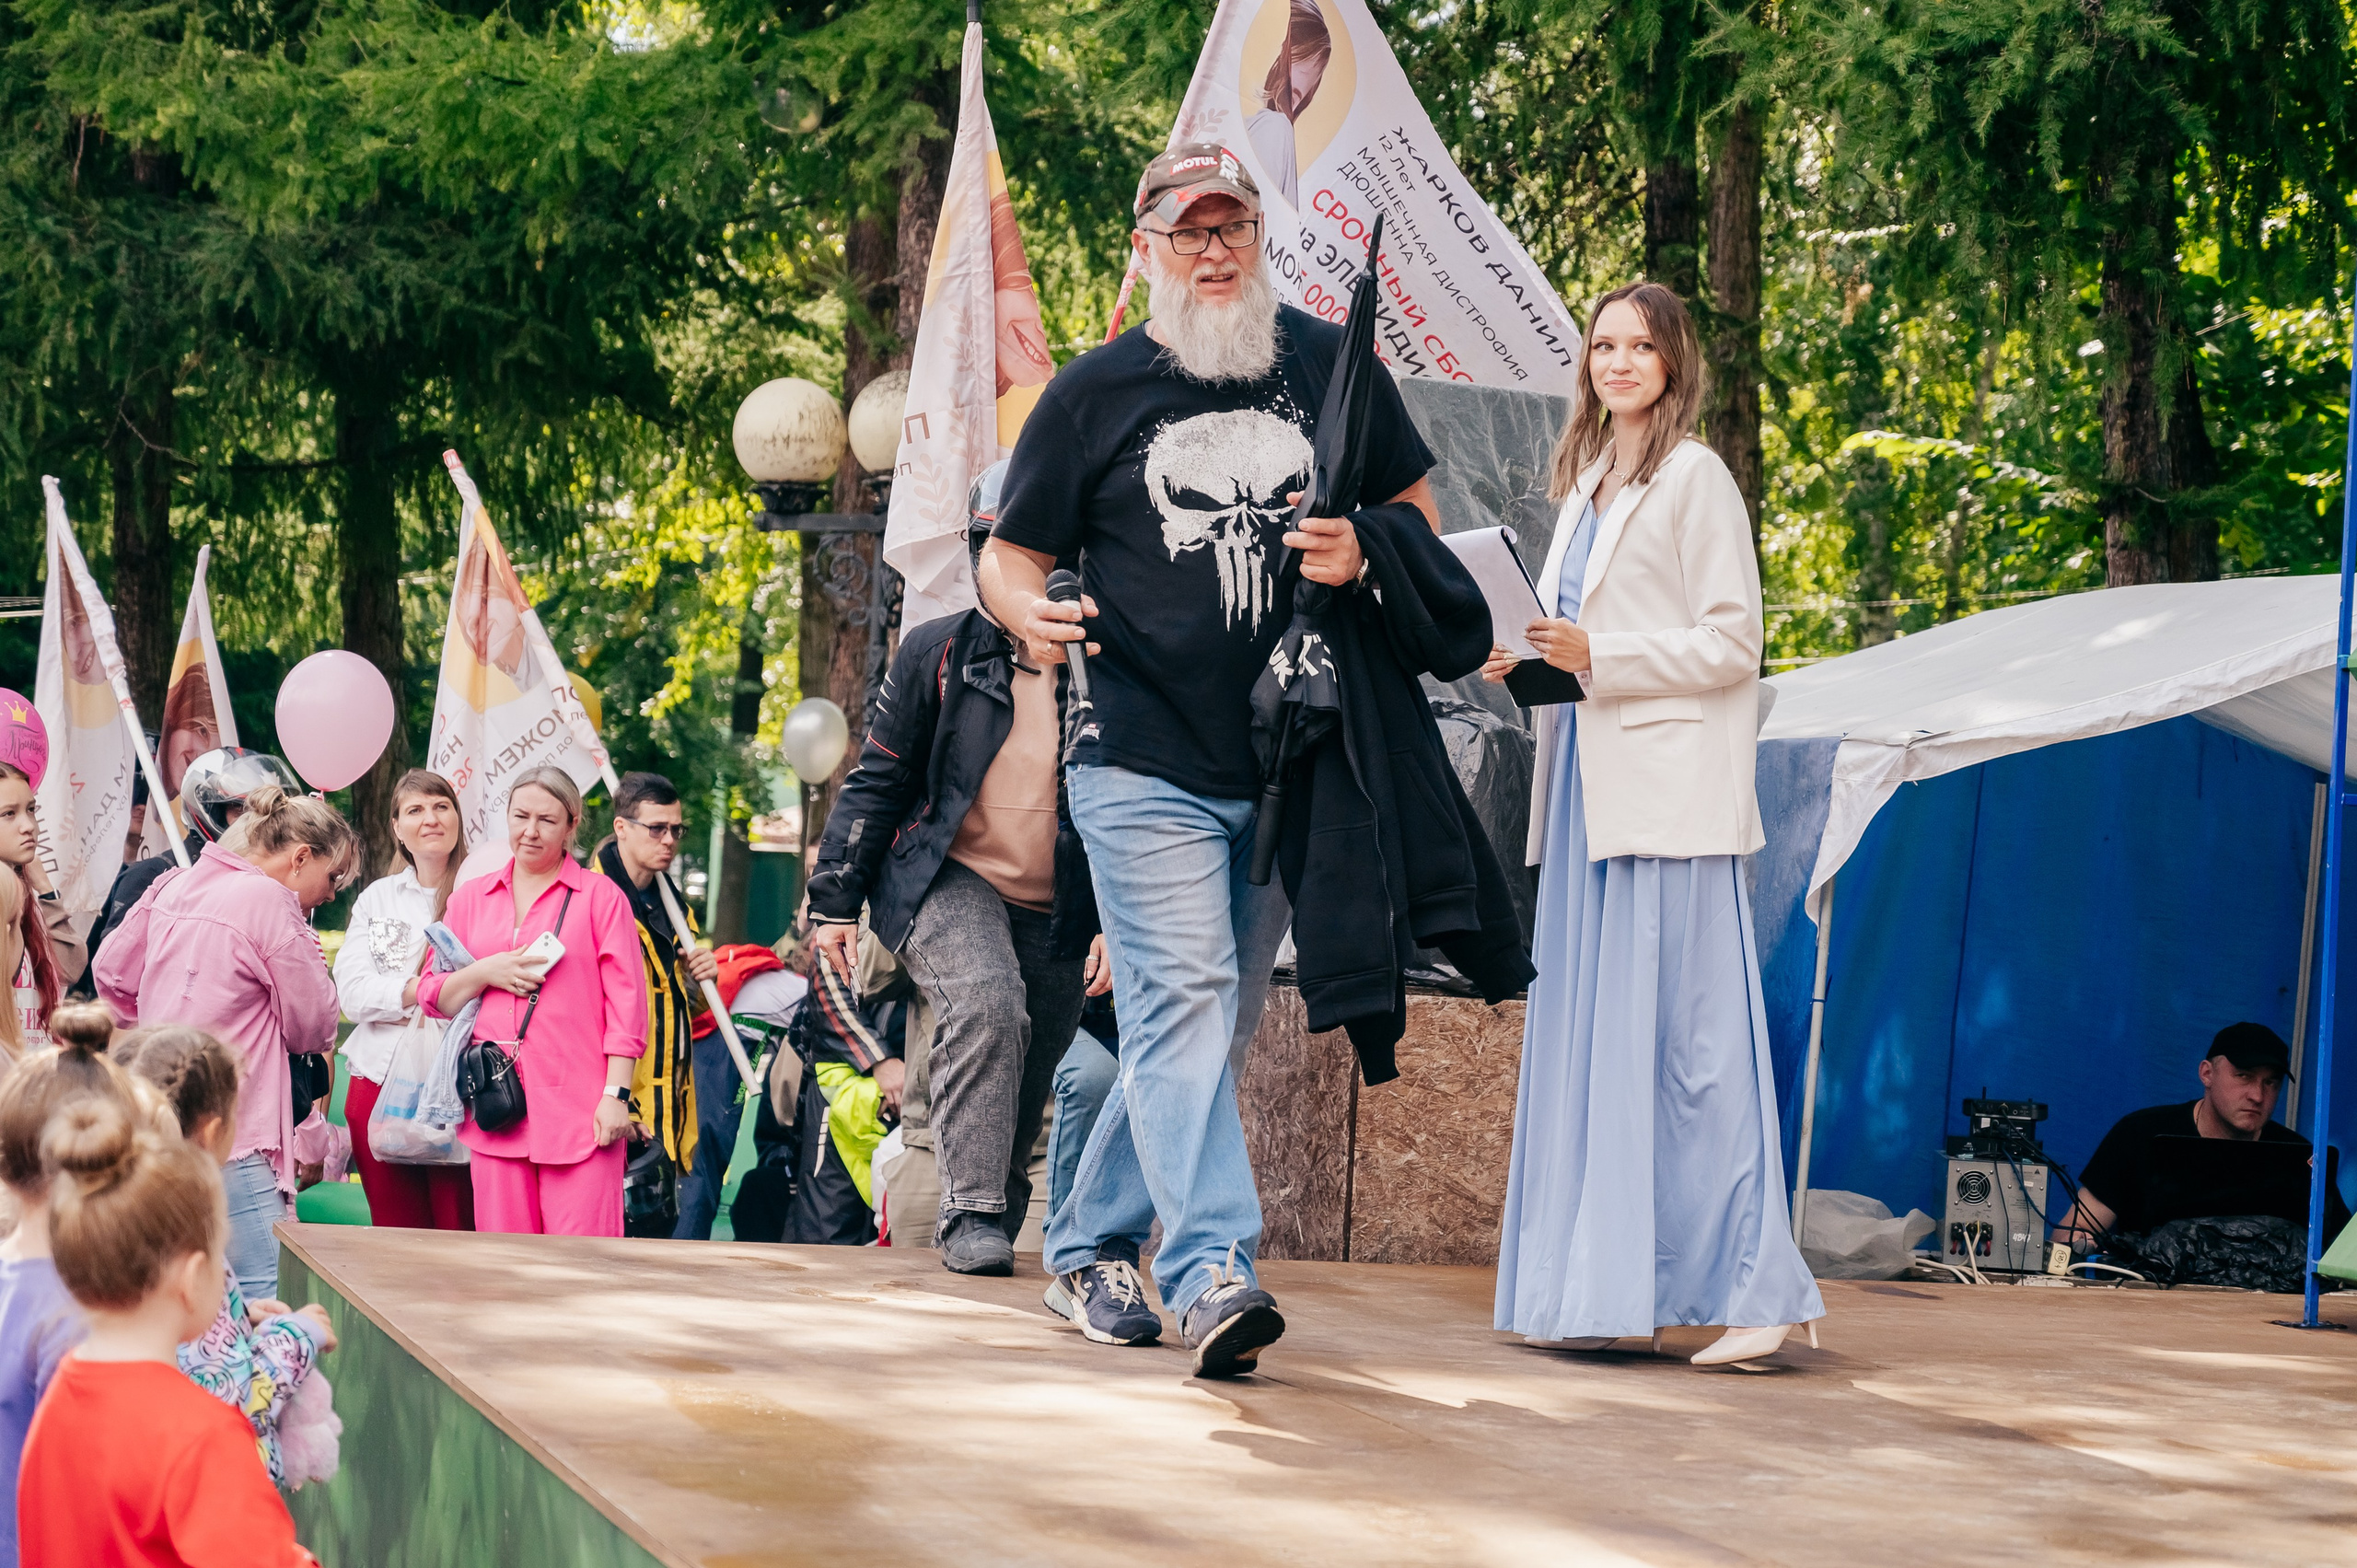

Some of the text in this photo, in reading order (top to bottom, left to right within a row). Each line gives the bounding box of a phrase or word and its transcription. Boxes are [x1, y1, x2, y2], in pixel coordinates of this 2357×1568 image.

[1172, 156, 1218, 174] MOTUL
[1378, 133, 1393, 153] 12
[1336, 161, 1414, 265] ДЮШЕННА
[1357, 146, 1528, 381] МЫШЕЧНАЯ ДИСТРОФИЯ
[1391, 125, 1573, 366] ЖАРКОВ ДАНИЛ
